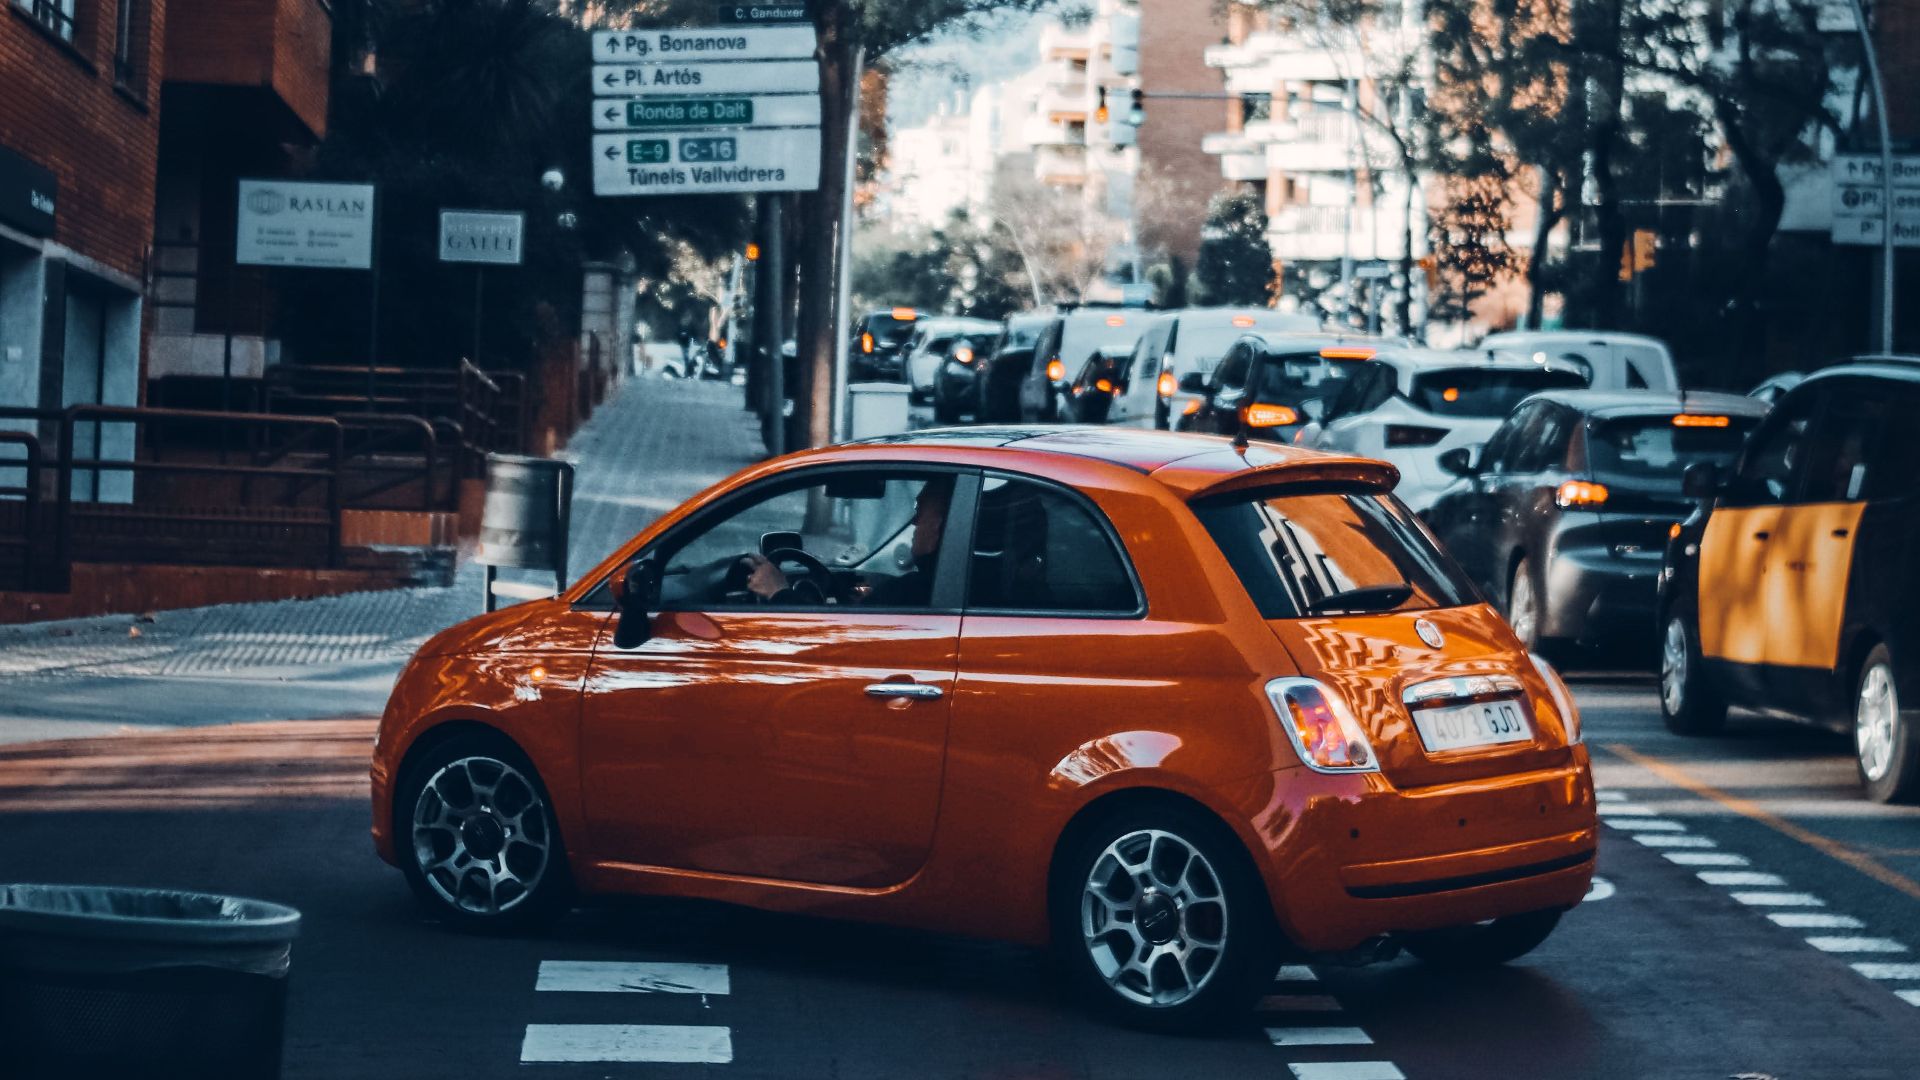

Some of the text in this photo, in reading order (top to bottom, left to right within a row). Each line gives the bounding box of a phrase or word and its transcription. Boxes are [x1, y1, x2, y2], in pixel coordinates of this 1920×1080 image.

[735, 7, 805, 19] C. Ganduxer
[625, 34, 747, 56] Pg. Bonanova
[625, 67, 702, 86] Pl. Artós
[633, 102, 747, 120] Ronda de Dalt
[632, 143, 664, 160] E-9
[682, 141, 732, 159] C-16
[627, 165, 785, 185] Túnels Vallvidrera
[289, 197, 365, 214] RASLAN
[1433, 704, 1521, 743] 4073 GJD
